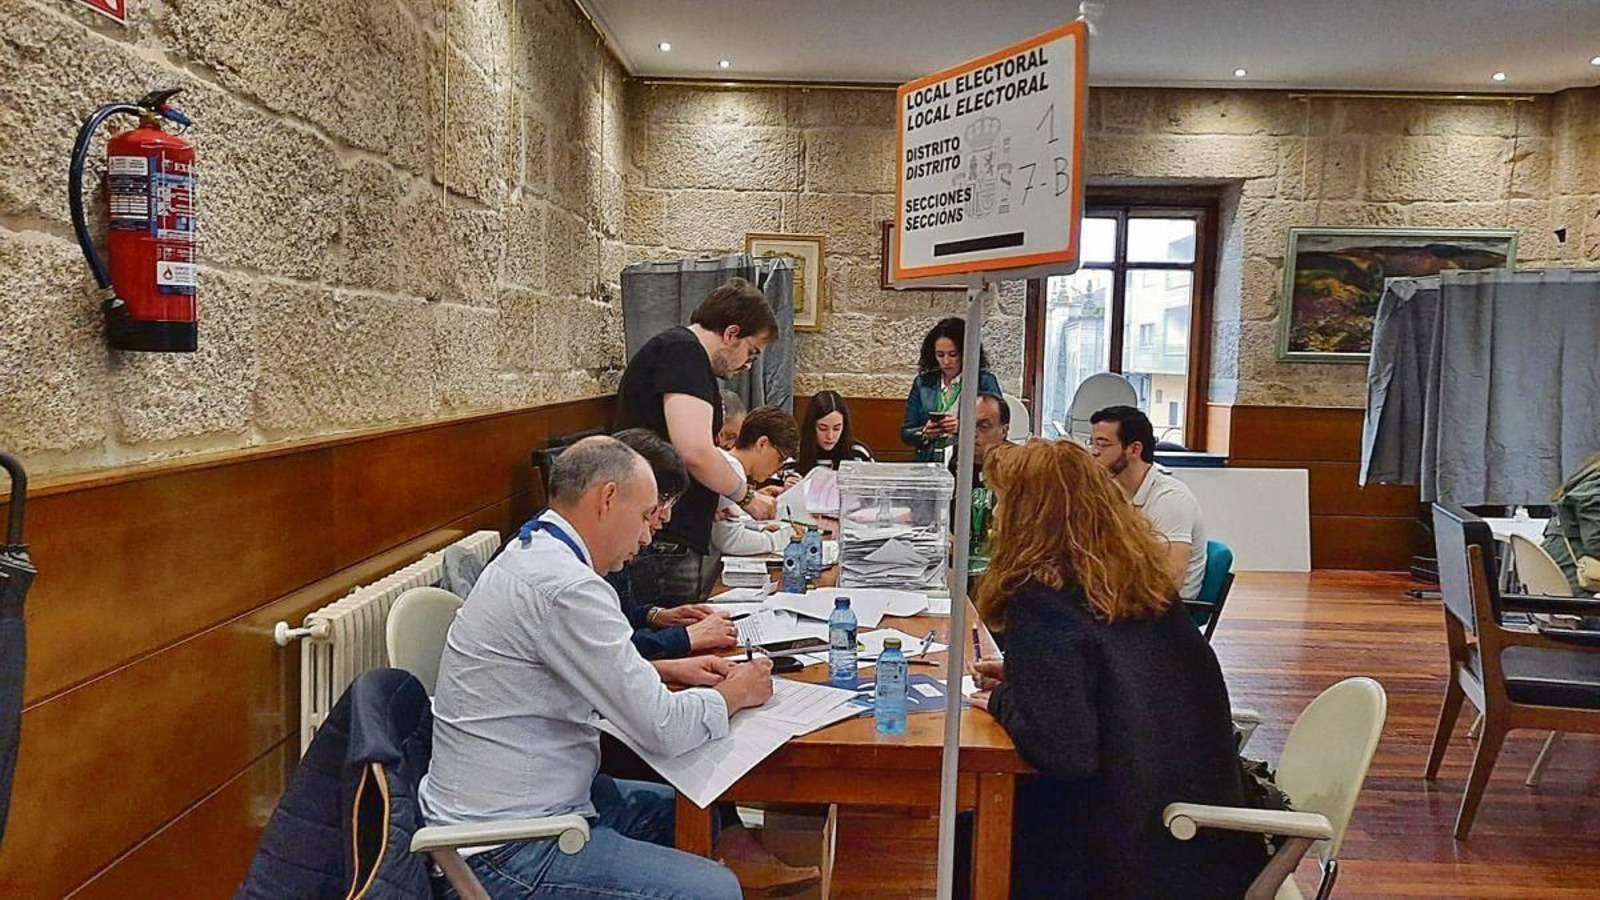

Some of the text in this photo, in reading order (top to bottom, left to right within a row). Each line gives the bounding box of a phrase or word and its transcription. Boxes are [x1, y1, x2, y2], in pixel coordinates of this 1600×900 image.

[906, 48, 1048, 110] LOCAL ELECTORAL
[906, 73, 1049, 131] LOCAL ELECTORAL
[1036, 103, 1059, 144] 1
[906, 136, 961, 163] DISTRITO
[906, 155, 961, 181] DISTRITO
[905, 187, 972, 213] SECCIONES
[905, 206, 964, 231] SECCIÓNS
